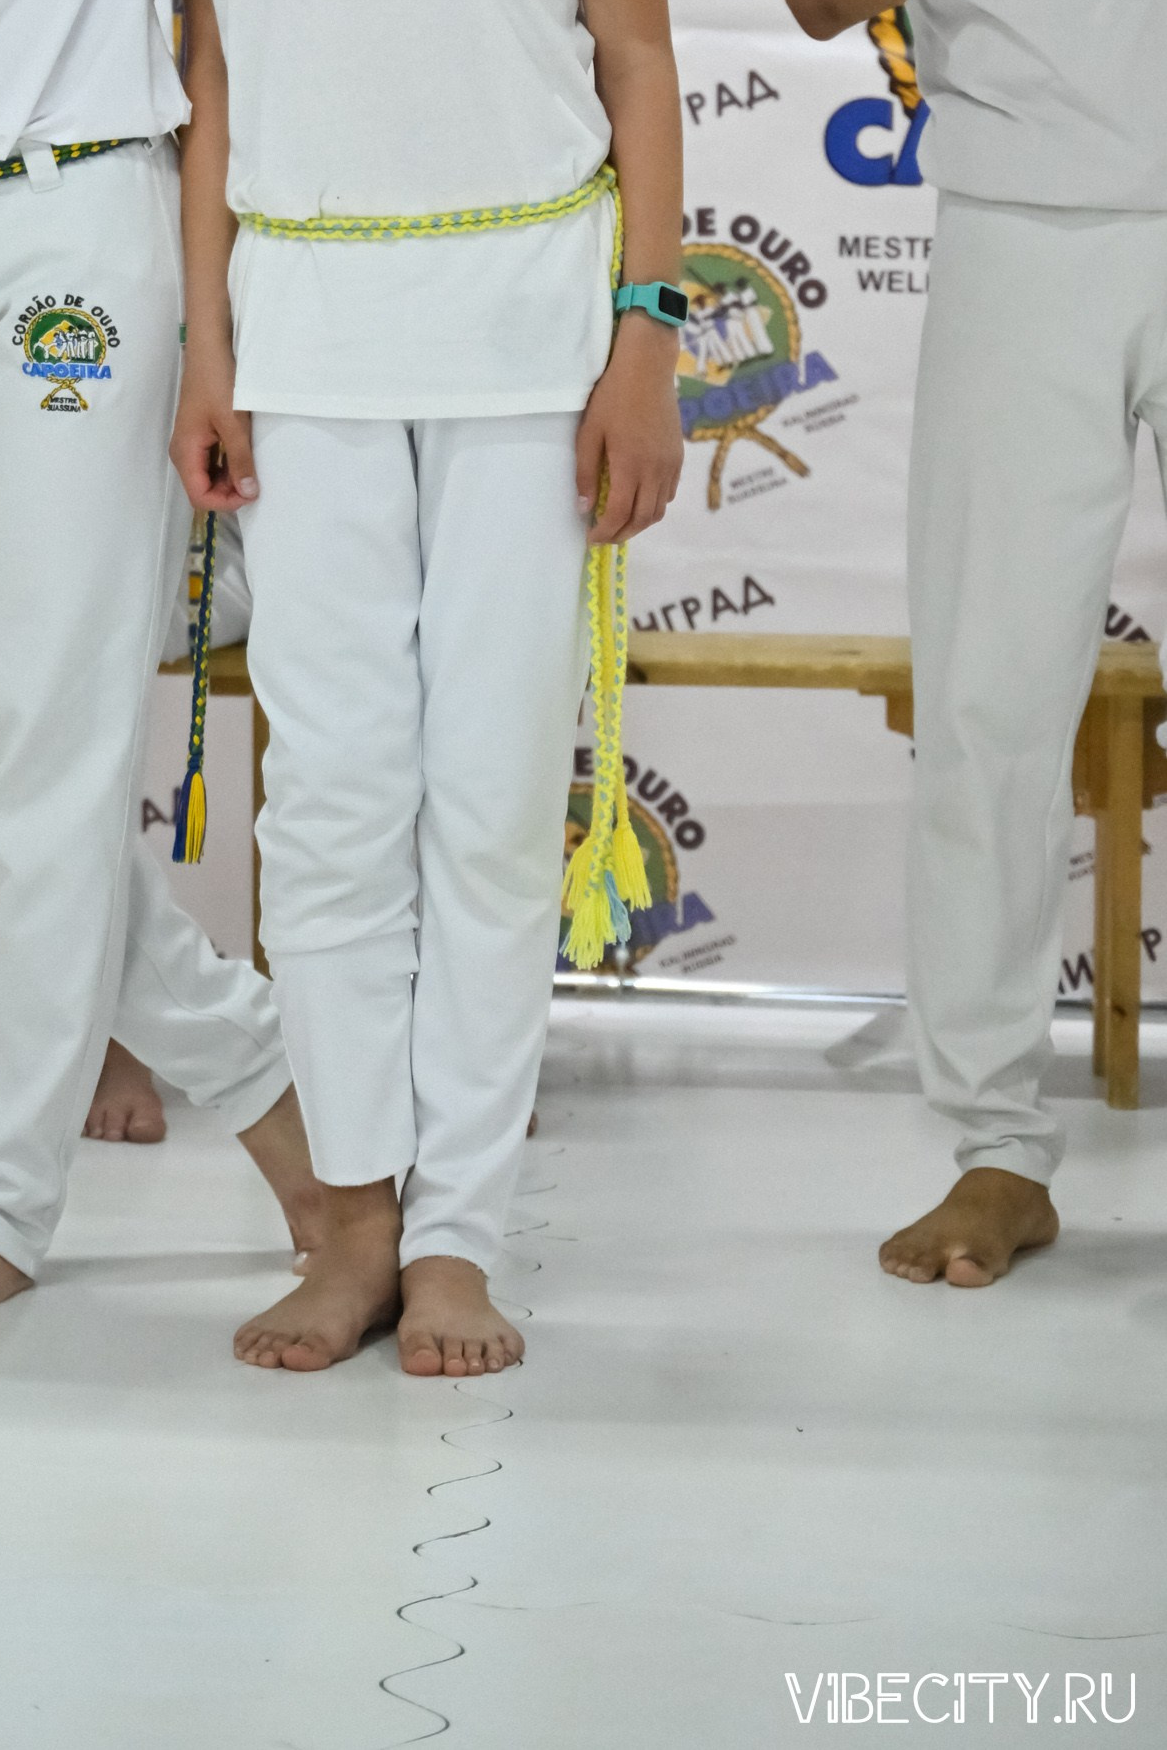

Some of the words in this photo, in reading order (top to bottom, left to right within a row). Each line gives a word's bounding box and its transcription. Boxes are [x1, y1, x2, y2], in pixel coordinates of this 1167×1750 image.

[730, 214, 828, 310] OURO
[838, 235, 934, 260] MEST
[12, 295, 56, 346] CORDÃO
[64, 294, 85, 308] DE
[91, 306, 120, 348] OURO
[22, 362, 112, 380] CAPOEIRA
